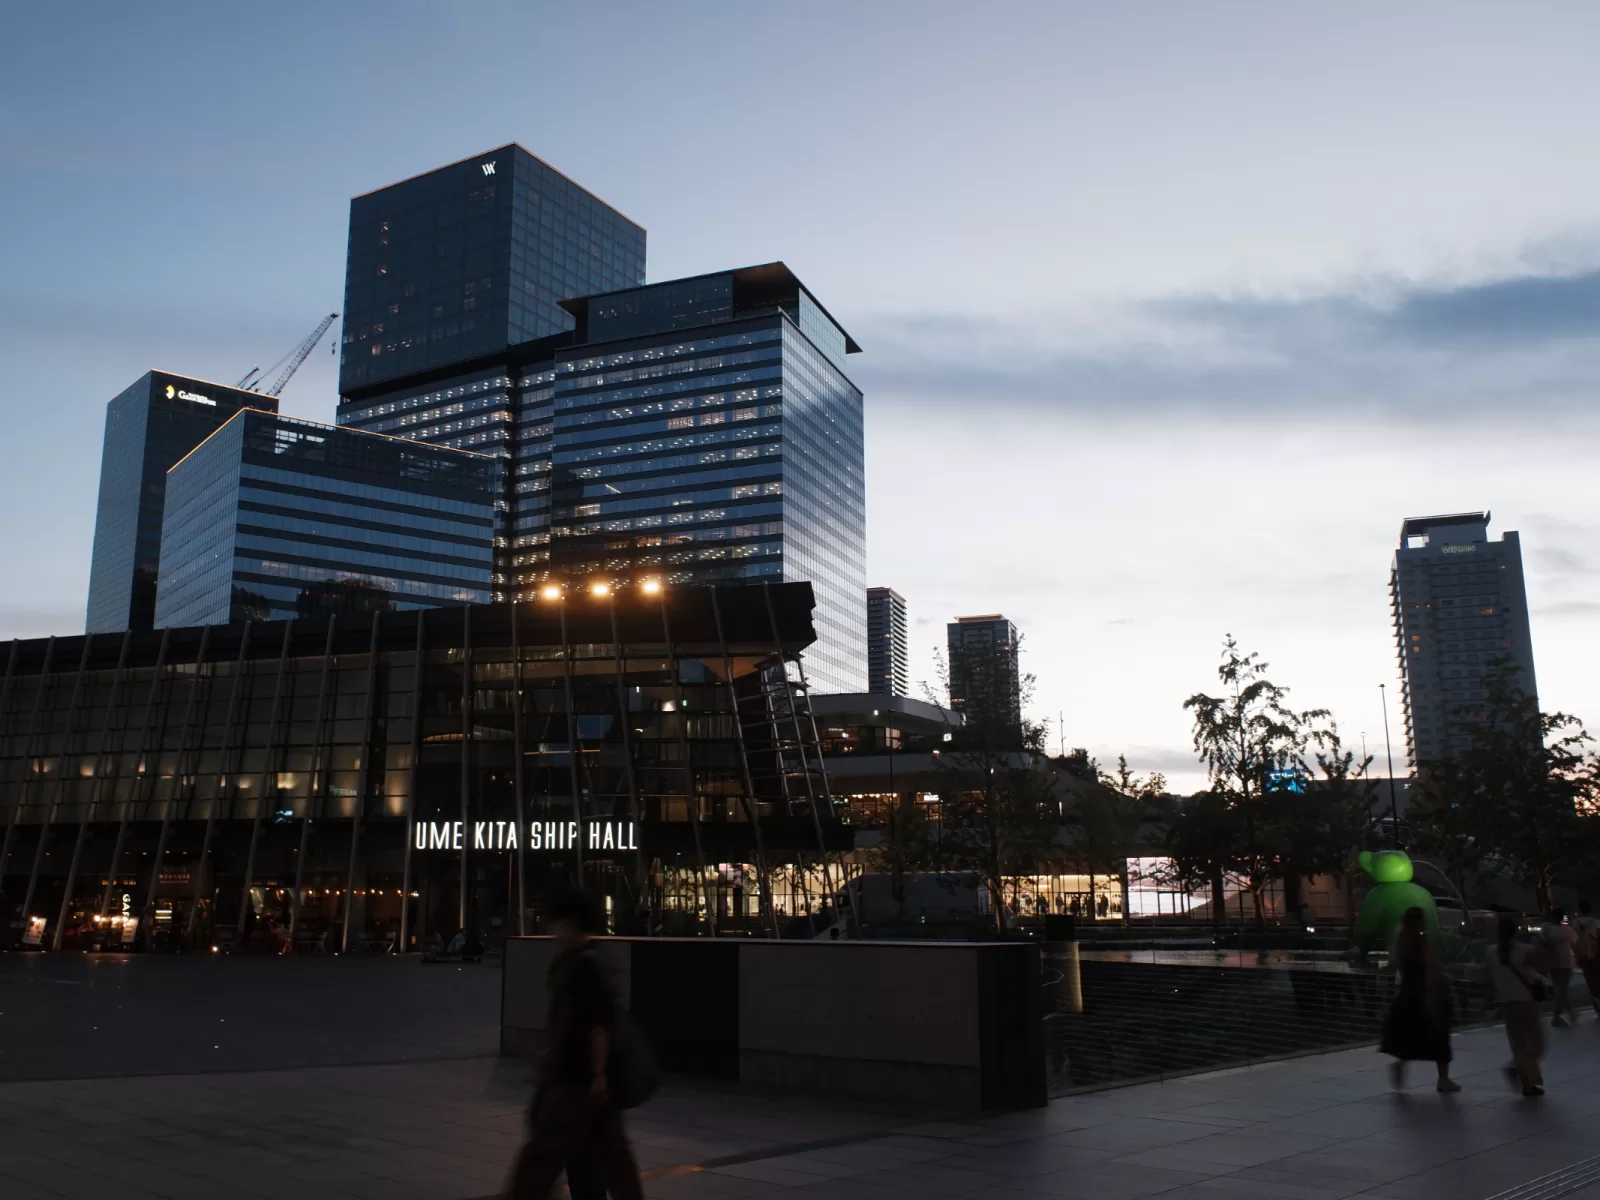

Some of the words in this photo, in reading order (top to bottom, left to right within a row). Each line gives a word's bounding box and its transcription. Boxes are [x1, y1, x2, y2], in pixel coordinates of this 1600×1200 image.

[416, 821, 463, 850] UME
[475, 821, 518, 850] KITA
[531, 821, 578, 850] SHIP
[589, 822, 638, 850] HALL
